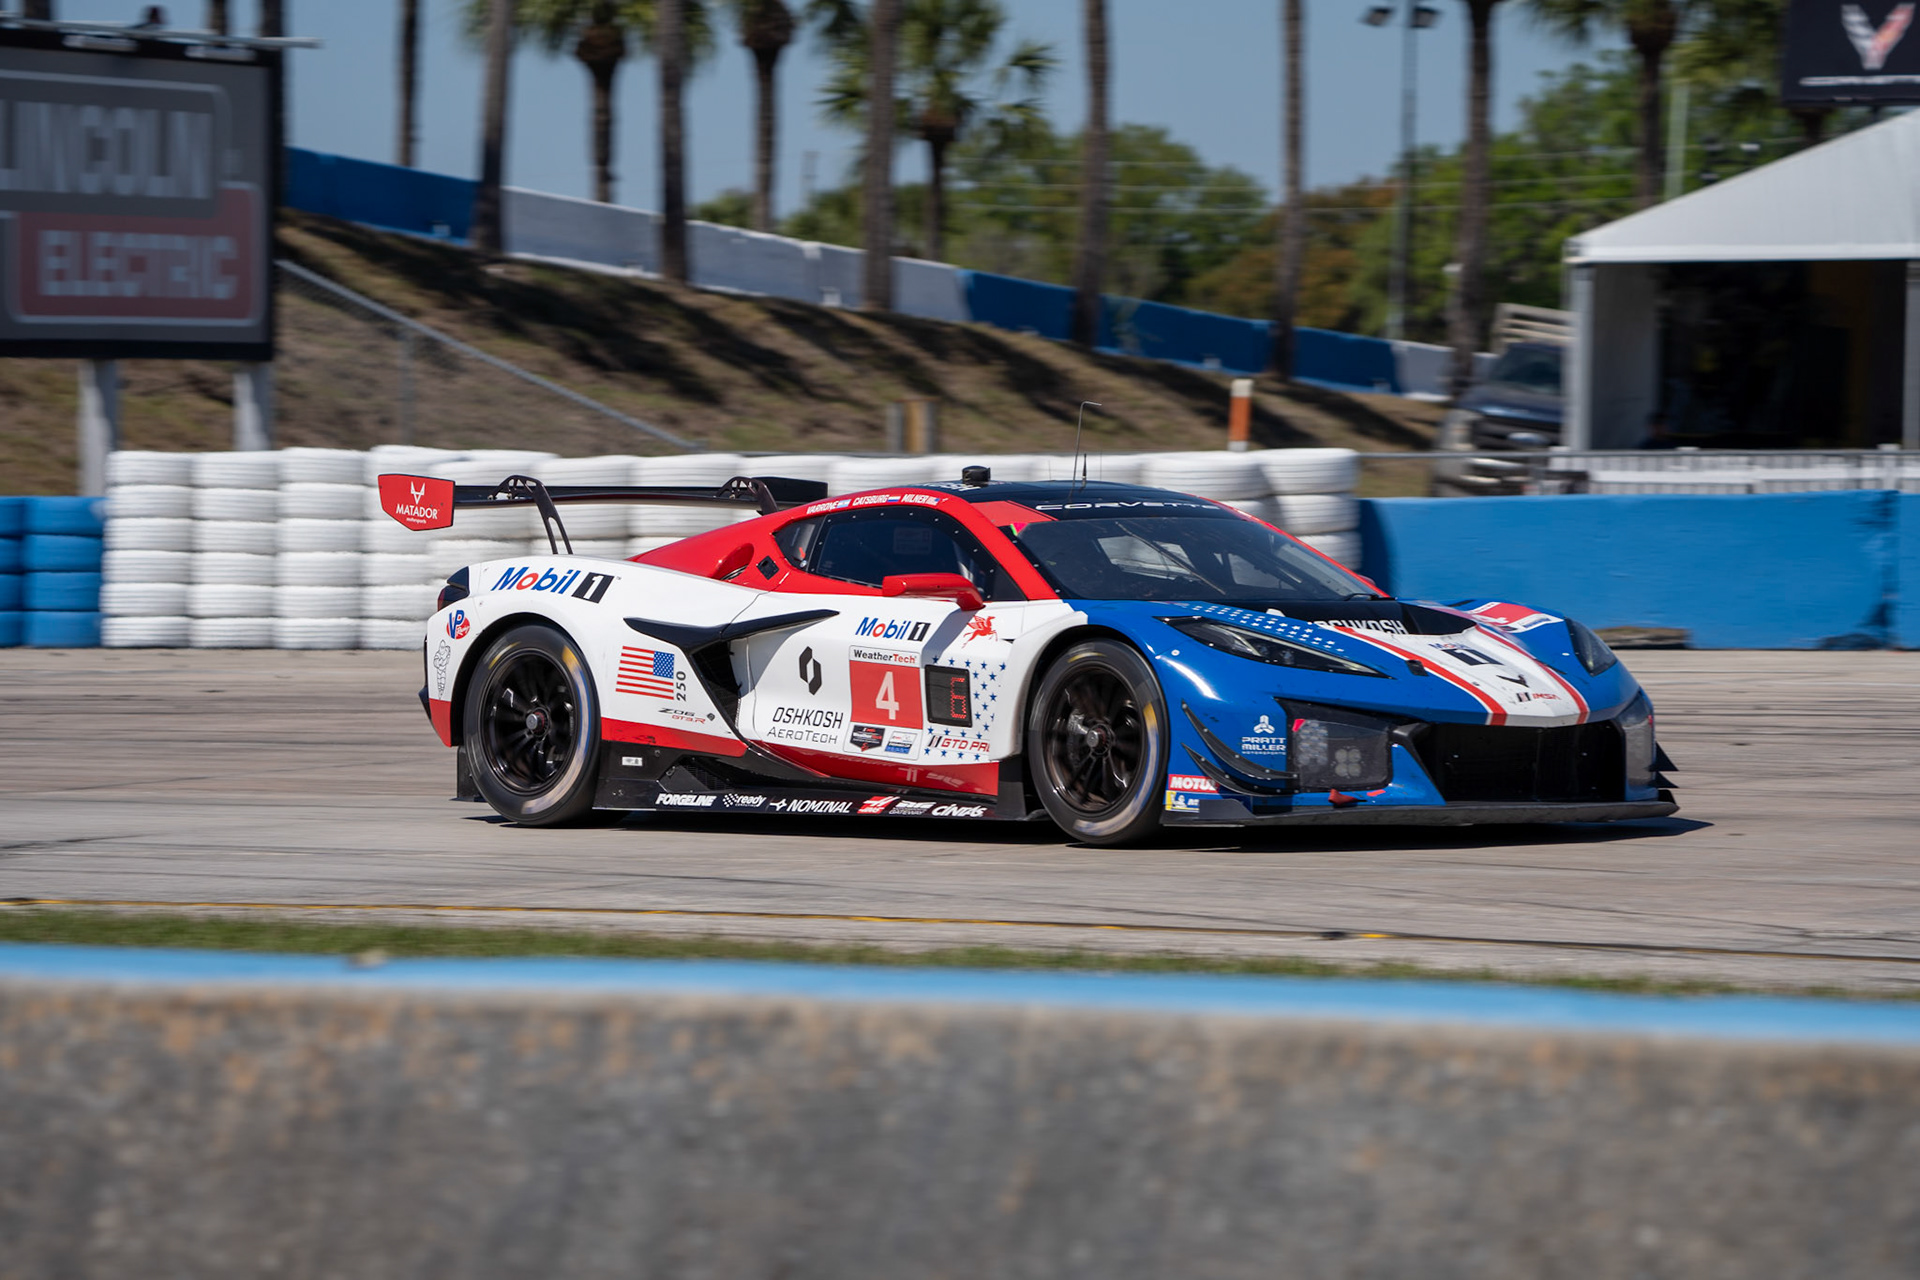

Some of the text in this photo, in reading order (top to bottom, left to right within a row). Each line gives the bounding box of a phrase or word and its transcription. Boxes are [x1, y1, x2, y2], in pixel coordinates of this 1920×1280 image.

[41, 230, 238, 299] ELECTRIC
[852, 495, 889, 506] CATSBURG
[901, 494, 929, 504] MILNER
[1035, 501, 1220, 510] CORVETTE
[396, 504, 438, 519] MATADOR
[490, 566, 607, 602] Mobil 1
[449, 610, 465, 639] VP
[855, 617, 928, 641] Mobil 1
[853, 649, 916, 663] WeatherTech
[676, 671, 686, 702] 250
[875, 671, 899, 720] 4
[950, 677, 966, 719] 6
[772, 706, 844, 729] OSHKOSH
[941, 738, 969, 749] GTD
[1241, 736, 1286, 744] PRATT
[1241, 743, 1286, 751] MILLER
[655, 793, 717, 807] FORGELINE
[737, 794, 767, 807] ready
[786, 799, 853, 813] NOMINAL
